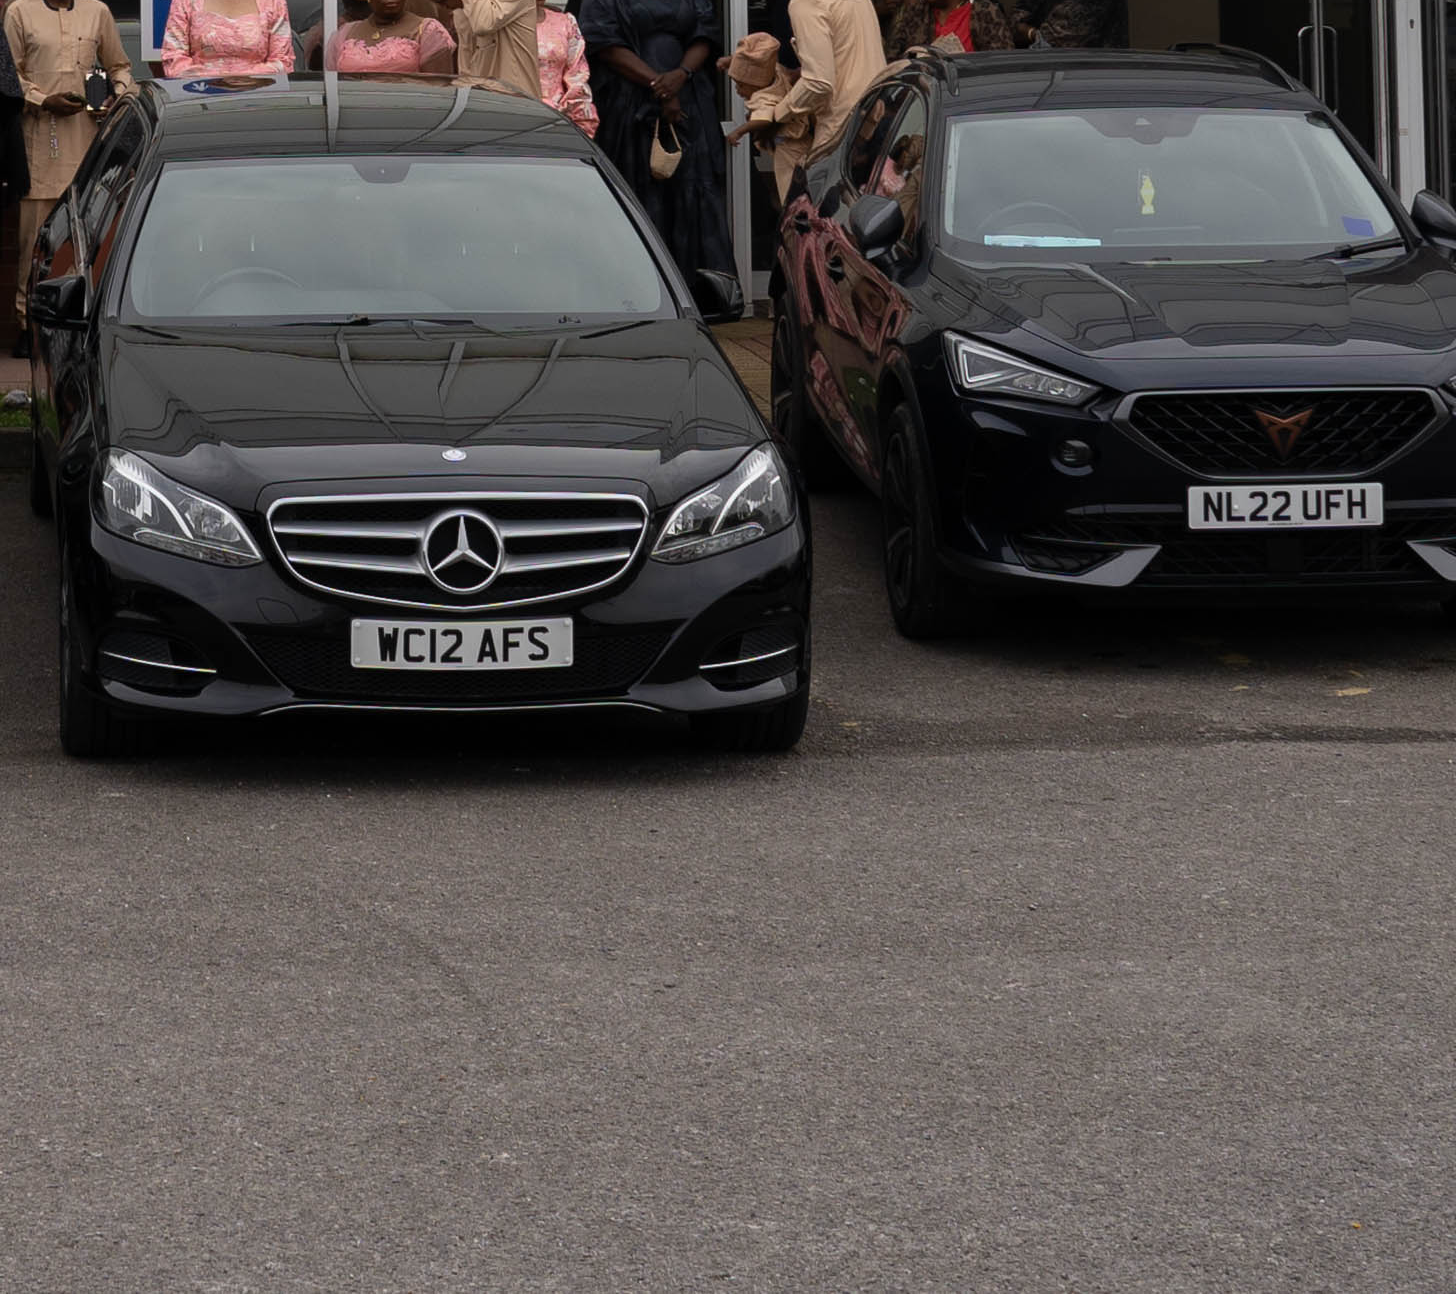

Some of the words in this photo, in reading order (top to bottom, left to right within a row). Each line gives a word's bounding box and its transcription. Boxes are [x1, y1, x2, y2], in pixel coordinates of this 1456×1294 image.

[1203, 491, 1292, 522] NL22
[1302, 489, 1367, 520] UFH
[378, 627, 464, 663] WC12
[477, 626, 550, 663] AFS
